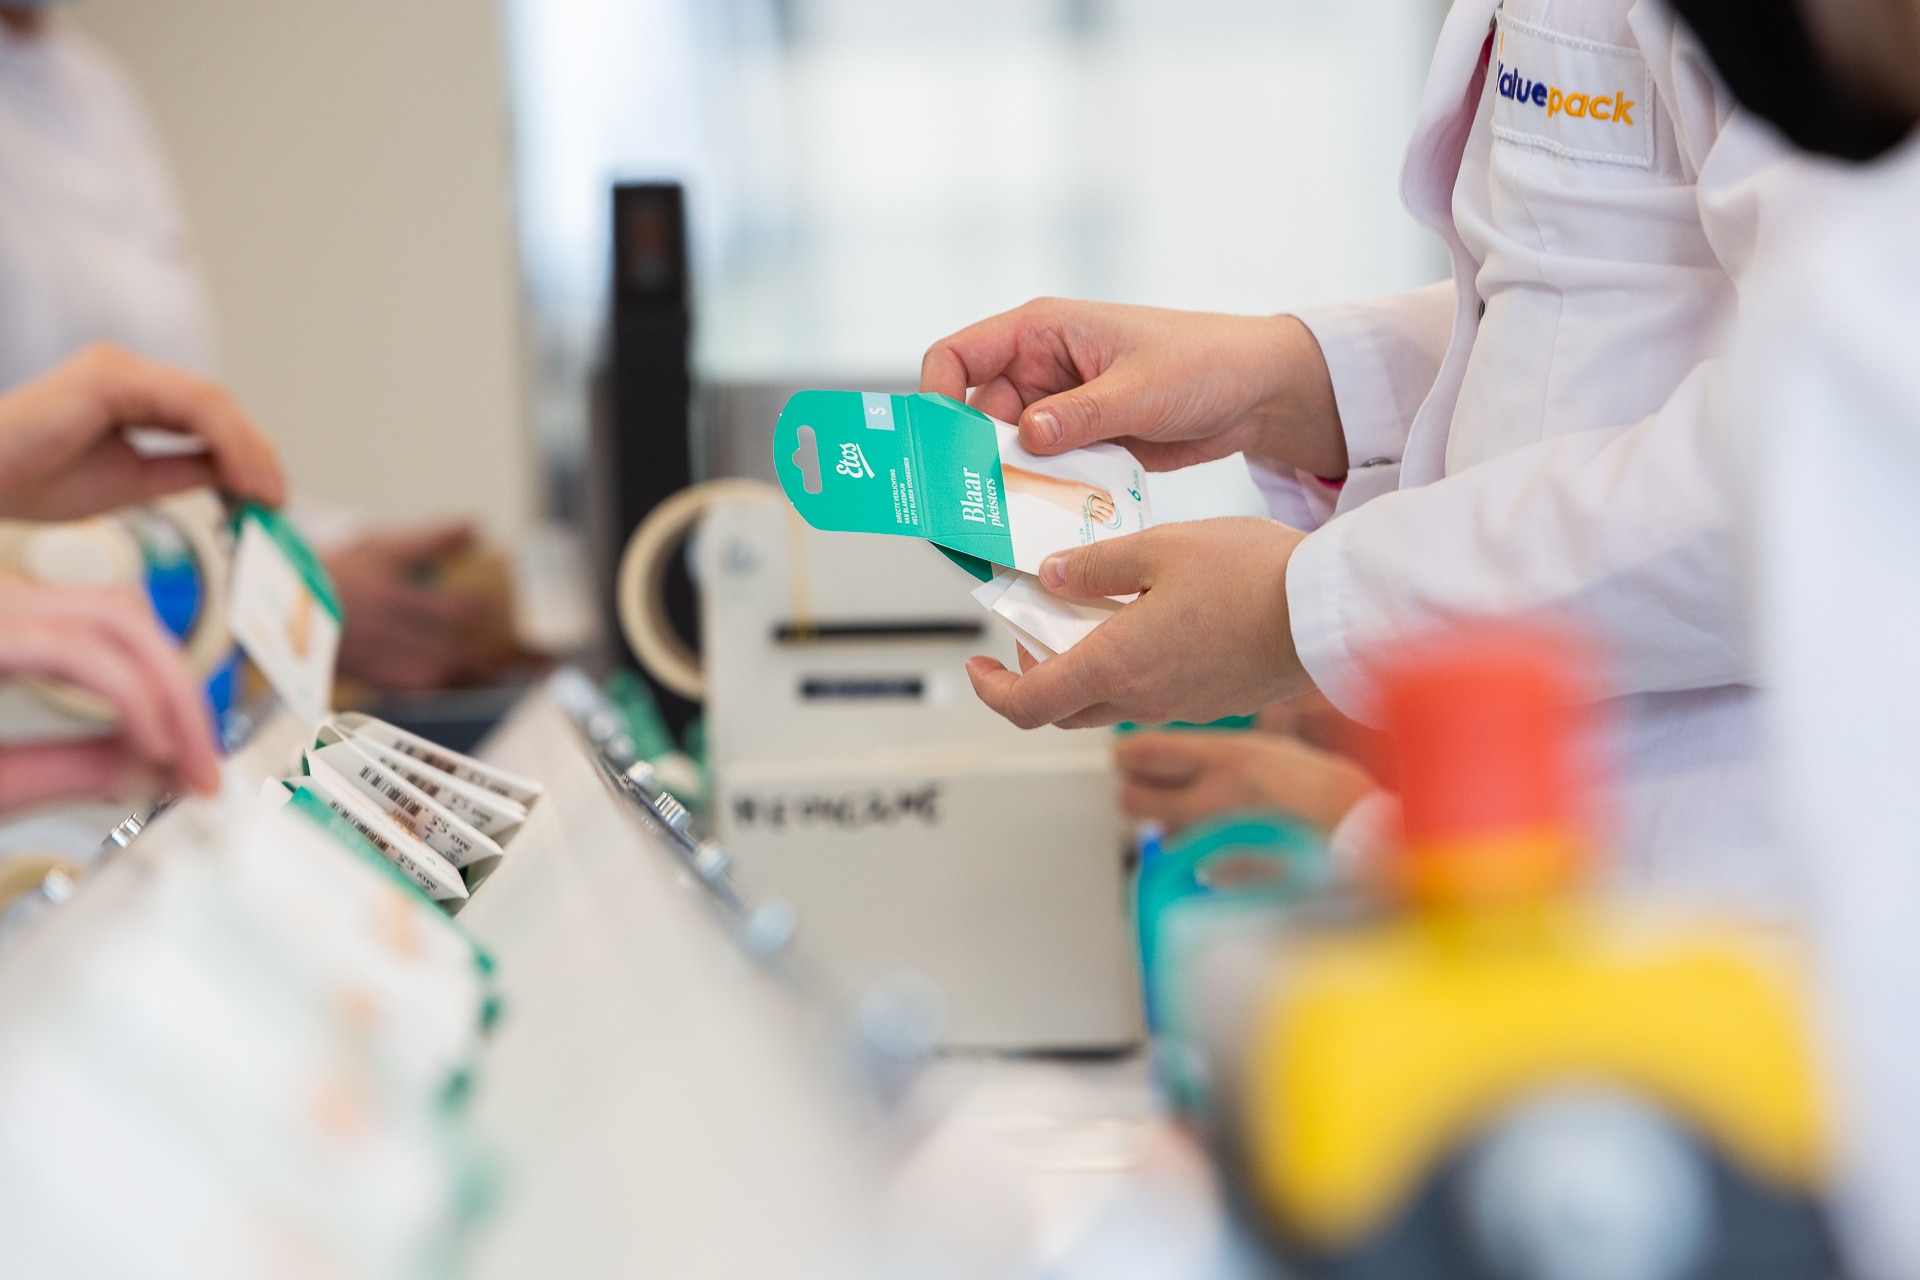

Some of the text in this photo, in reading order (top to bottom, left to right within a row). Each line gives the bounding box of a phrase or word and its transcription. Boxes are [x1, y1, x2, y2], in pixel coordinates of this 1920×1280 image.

[868, 406, 887, 416] S
[836, 442, 865, 479] Etos
[903, 457, 913, 488] VOORKOMEN
[889, 469, 902, 523] DIRECTE VERLICHTING
[900, 483, 909, 513] BLARENPIJN
[908, 489, 916, 508] BLAREN
[960, 467, 986, 524] Blaar
[985, 478, 1005, 527] pleisters
[1127, 486, 1142, 501] 6
